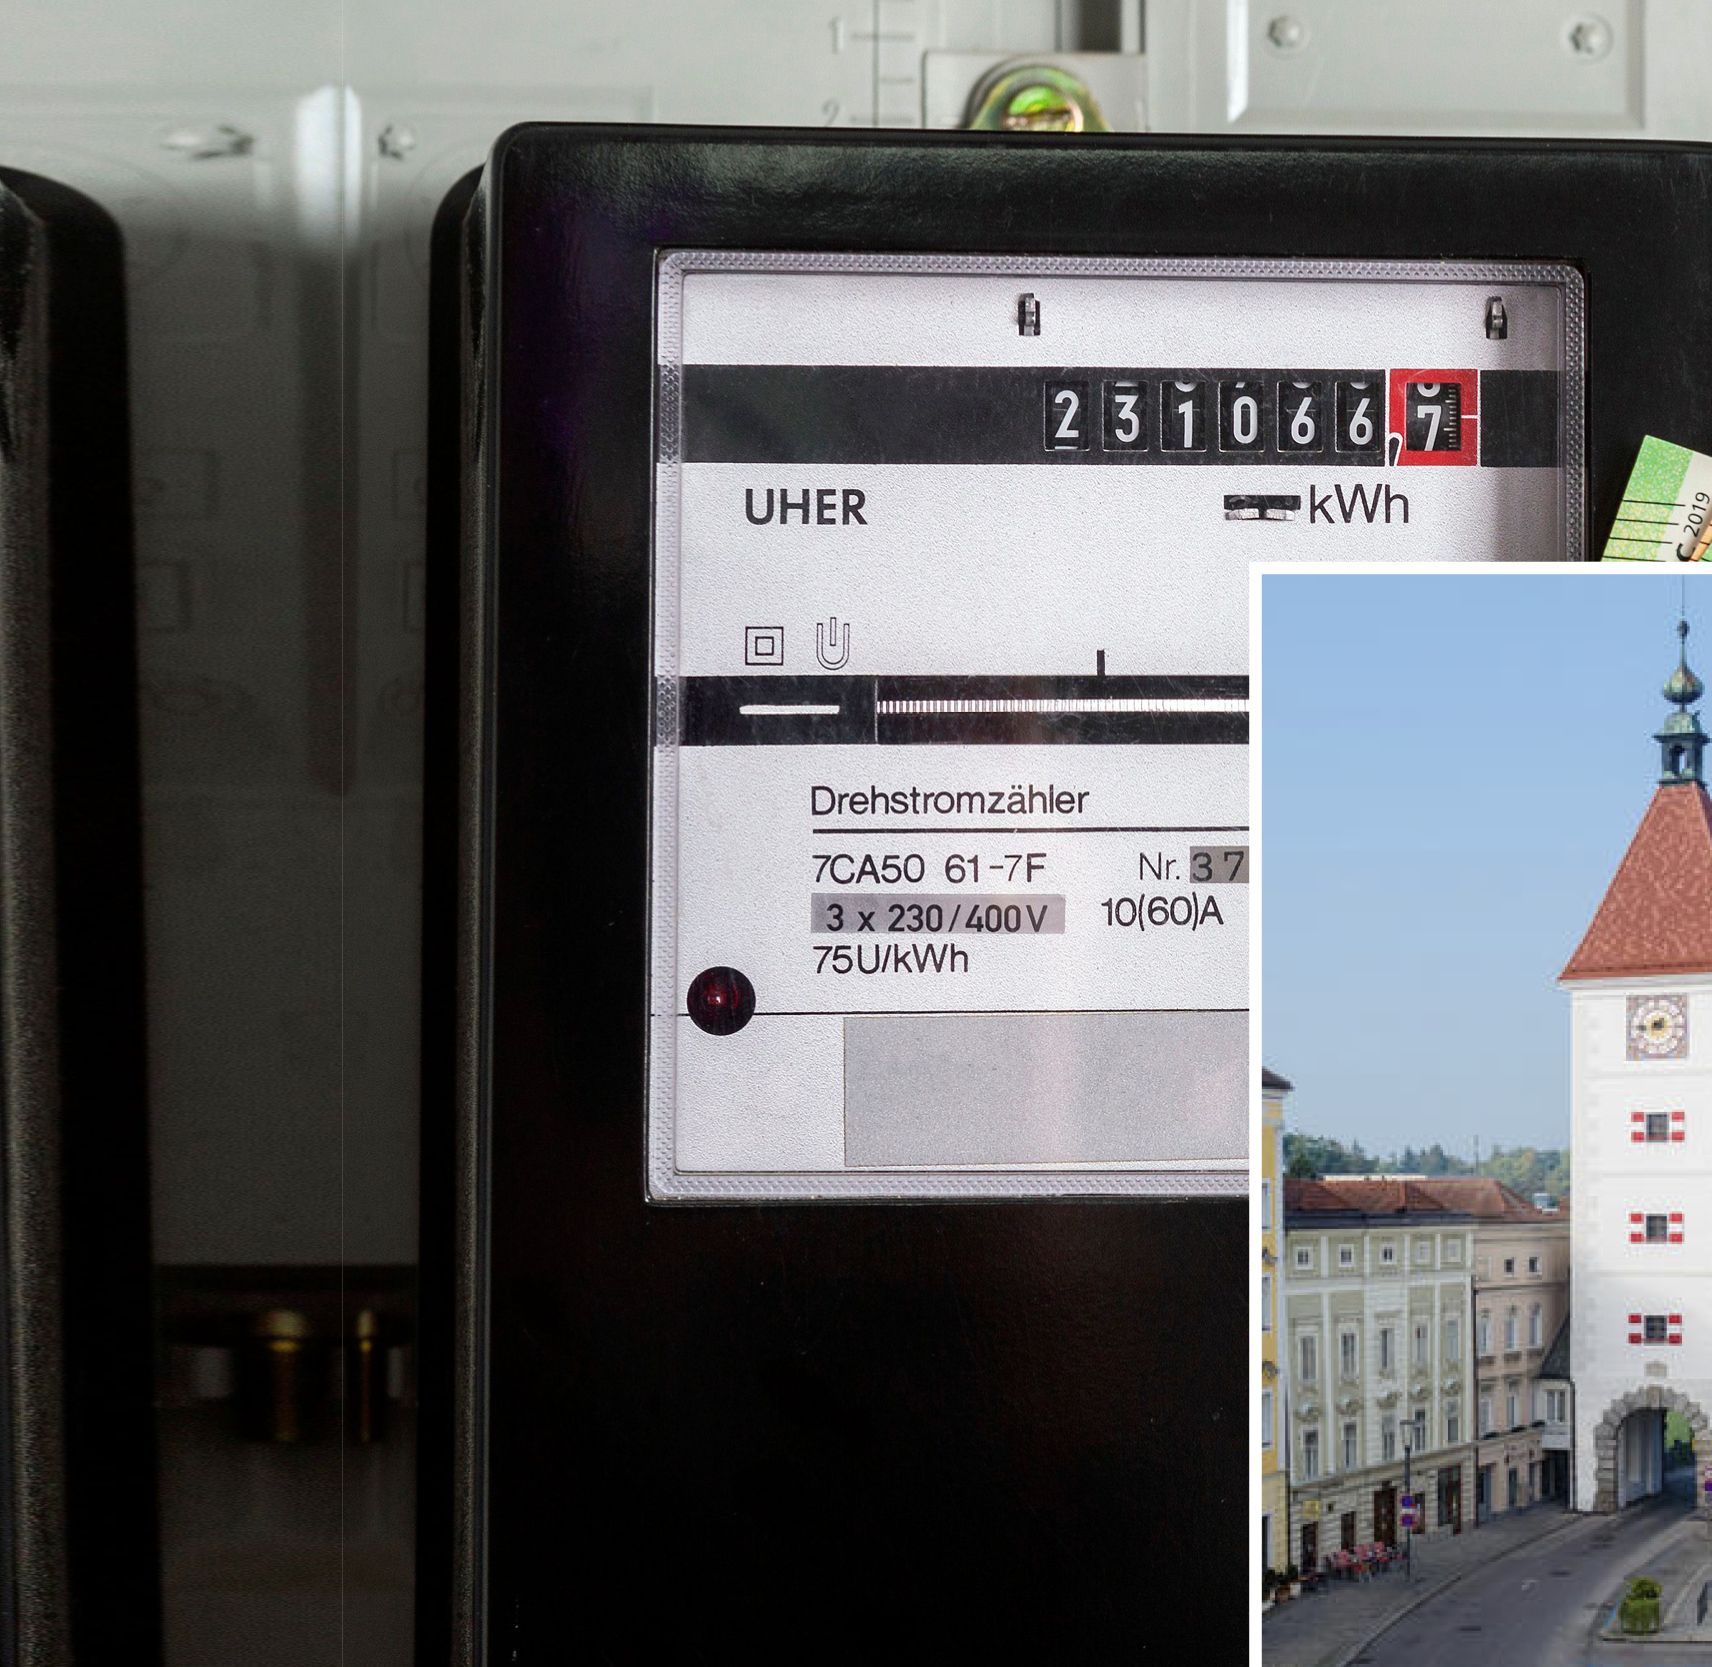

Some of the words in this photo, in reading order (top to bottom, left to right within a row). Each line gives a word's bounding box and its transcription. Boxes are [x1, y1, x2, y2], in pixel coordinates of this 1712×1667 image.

[744, 488, 868, 526] UHER
[1309, 483, 1410, 525] kWh
[1683, 491, 1711, 538] 2019
[811, 784, 1090, 817] Drehstromzähler
[811, 853, 925, 884] 7CA50
[1138, 853, 1182, 883] Nr.
[825, 903, 845, 932] 3
[857, 910, 875, 931] x
[1100, 893, 1225, 930] 10(60)A
[811, 943, 970, 975] 75U/kWh
